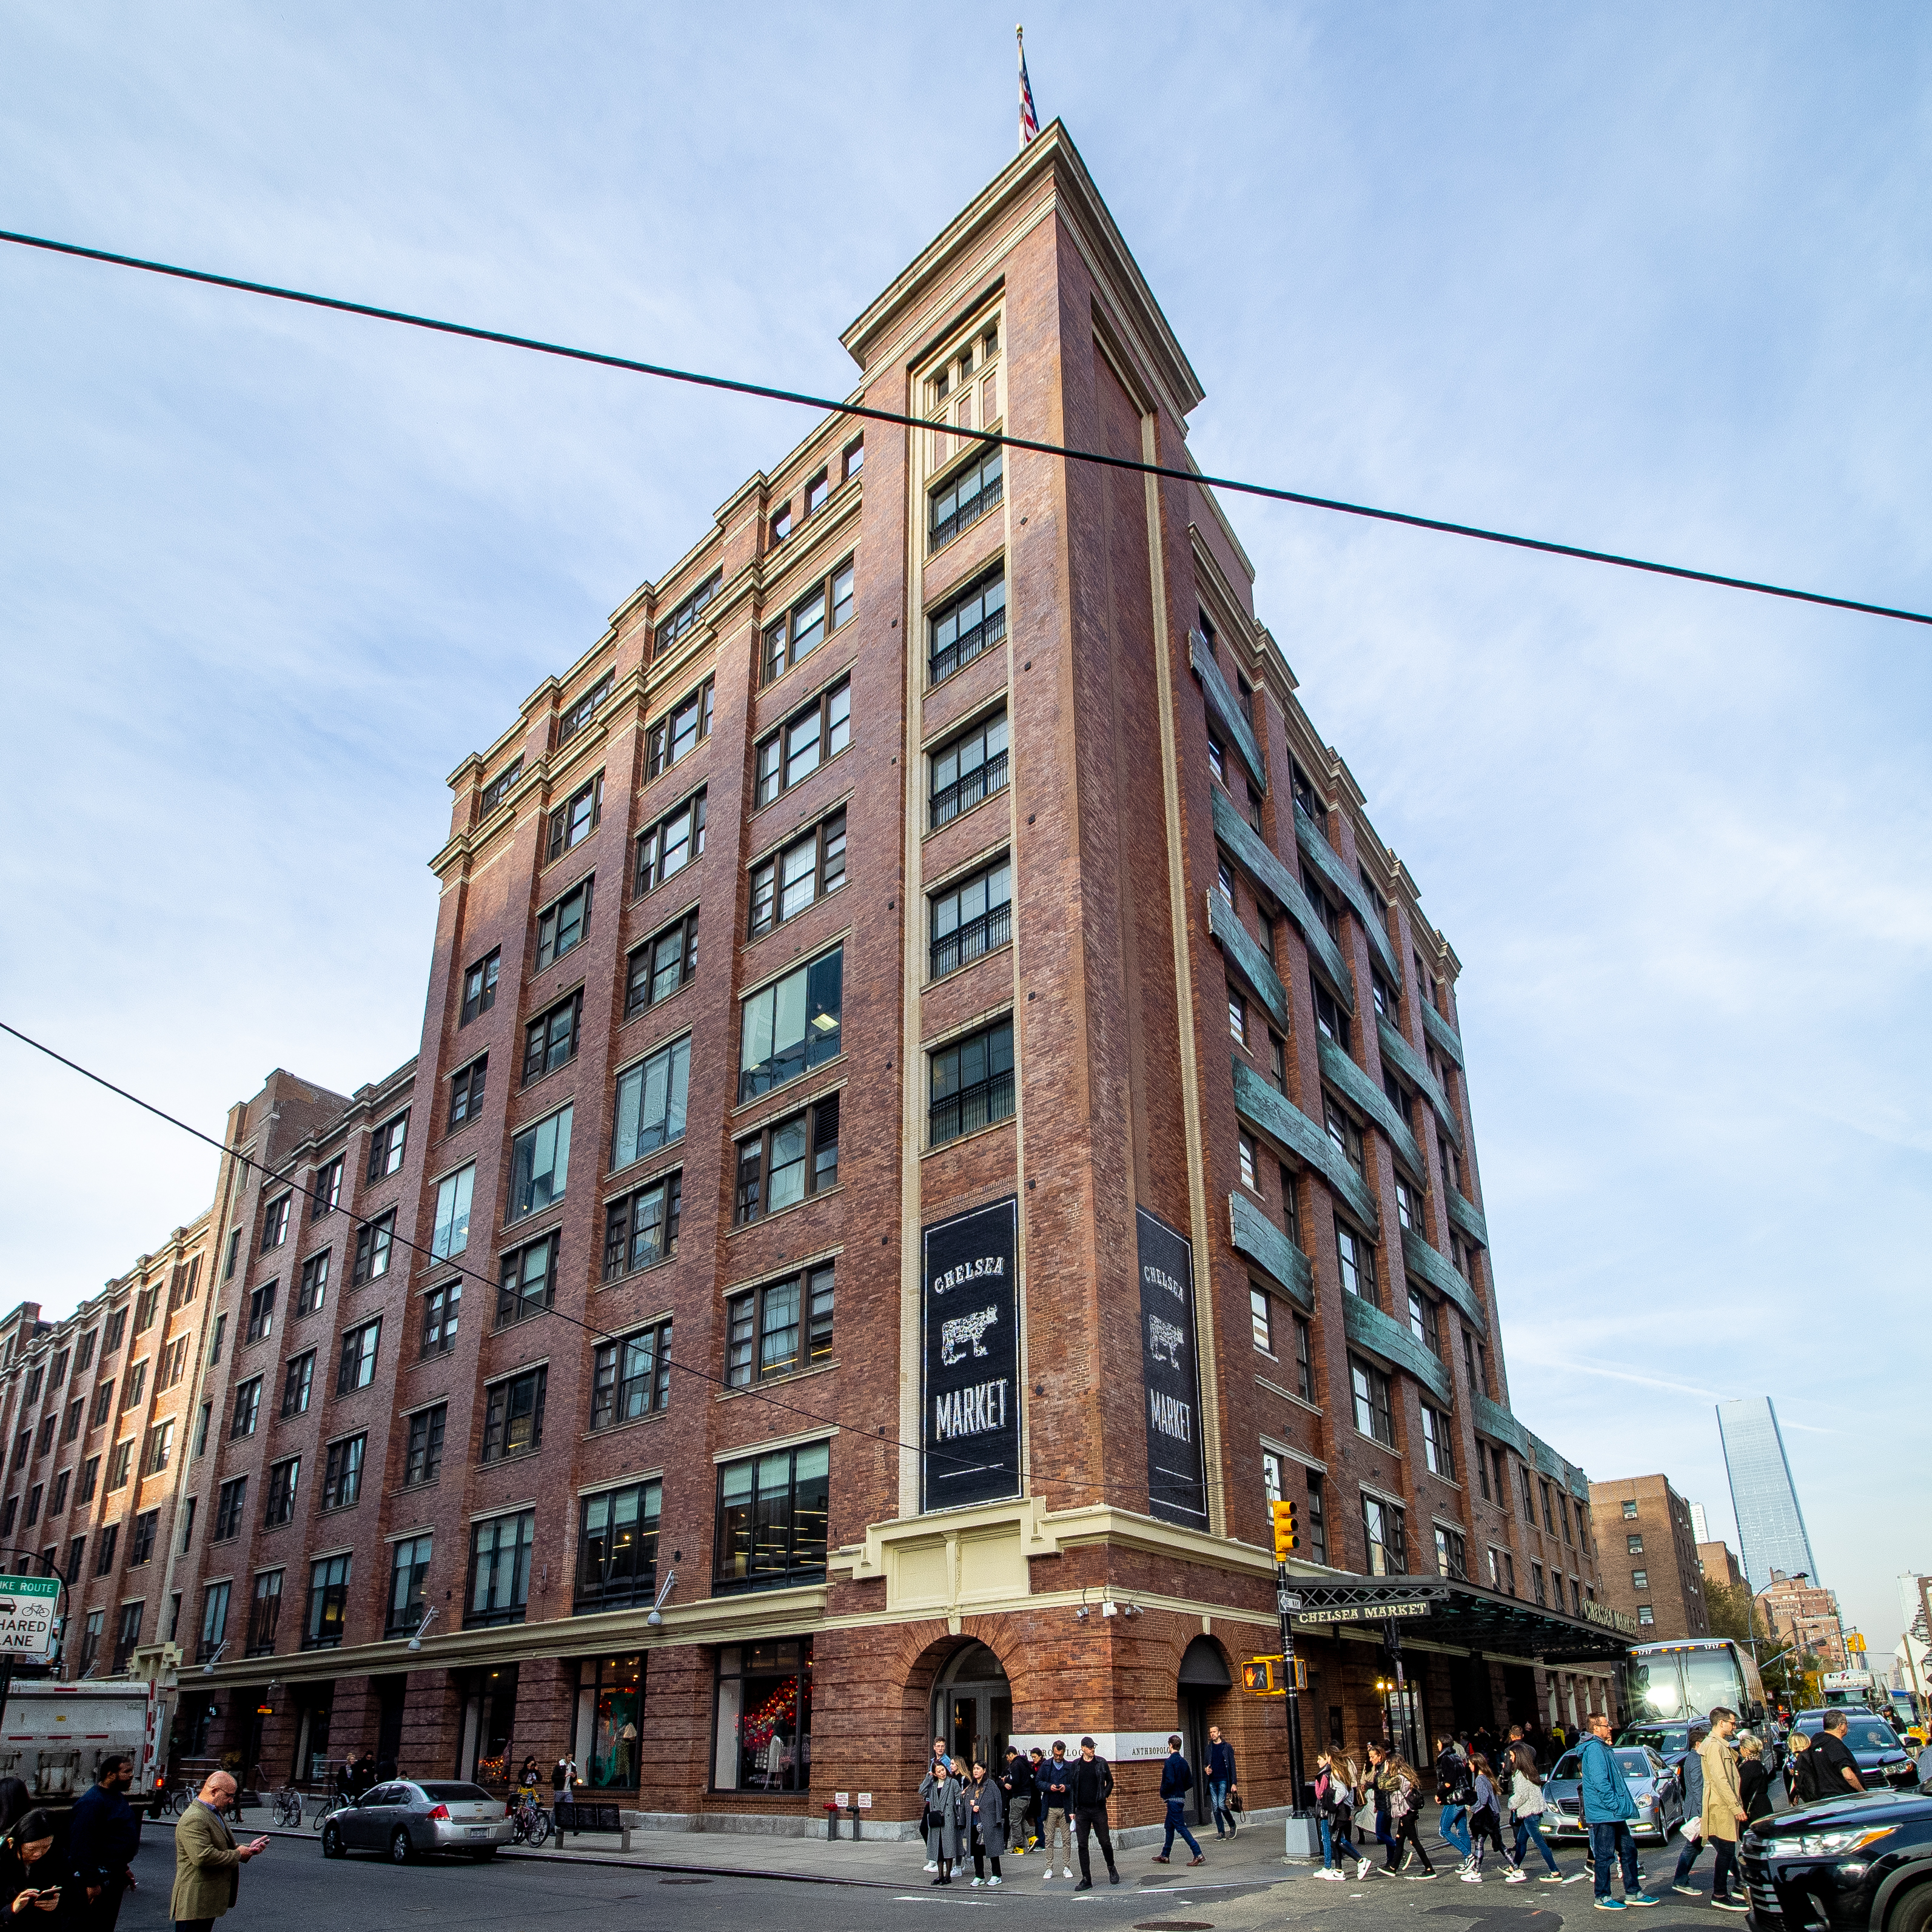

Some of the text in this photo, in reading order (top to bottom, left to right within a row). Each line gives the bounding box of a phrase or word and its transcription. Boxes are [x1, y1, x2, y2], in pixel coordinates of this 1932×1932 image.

[934, 1256, 1004, 1295] CHELSEA
[1144, 1265, 1184, 1304] CHELSEA
[936, 1378, 1008, 1442] MARKET
[1150, 1388, 1191, 1443] MARKET
[0, 1581, 54, 1593] IKE ROUTE
[0, 1618, 47, 1632] HARED
[1299, 1603, 1426, 1624] CHELSEA MARKET
[1584, 1599, 1637, 1635] CHELSEA MARKET
[0, 1634, 34, 1647] ANE
[1132, 1746, 1170, 1756] ANTHROPOLO
